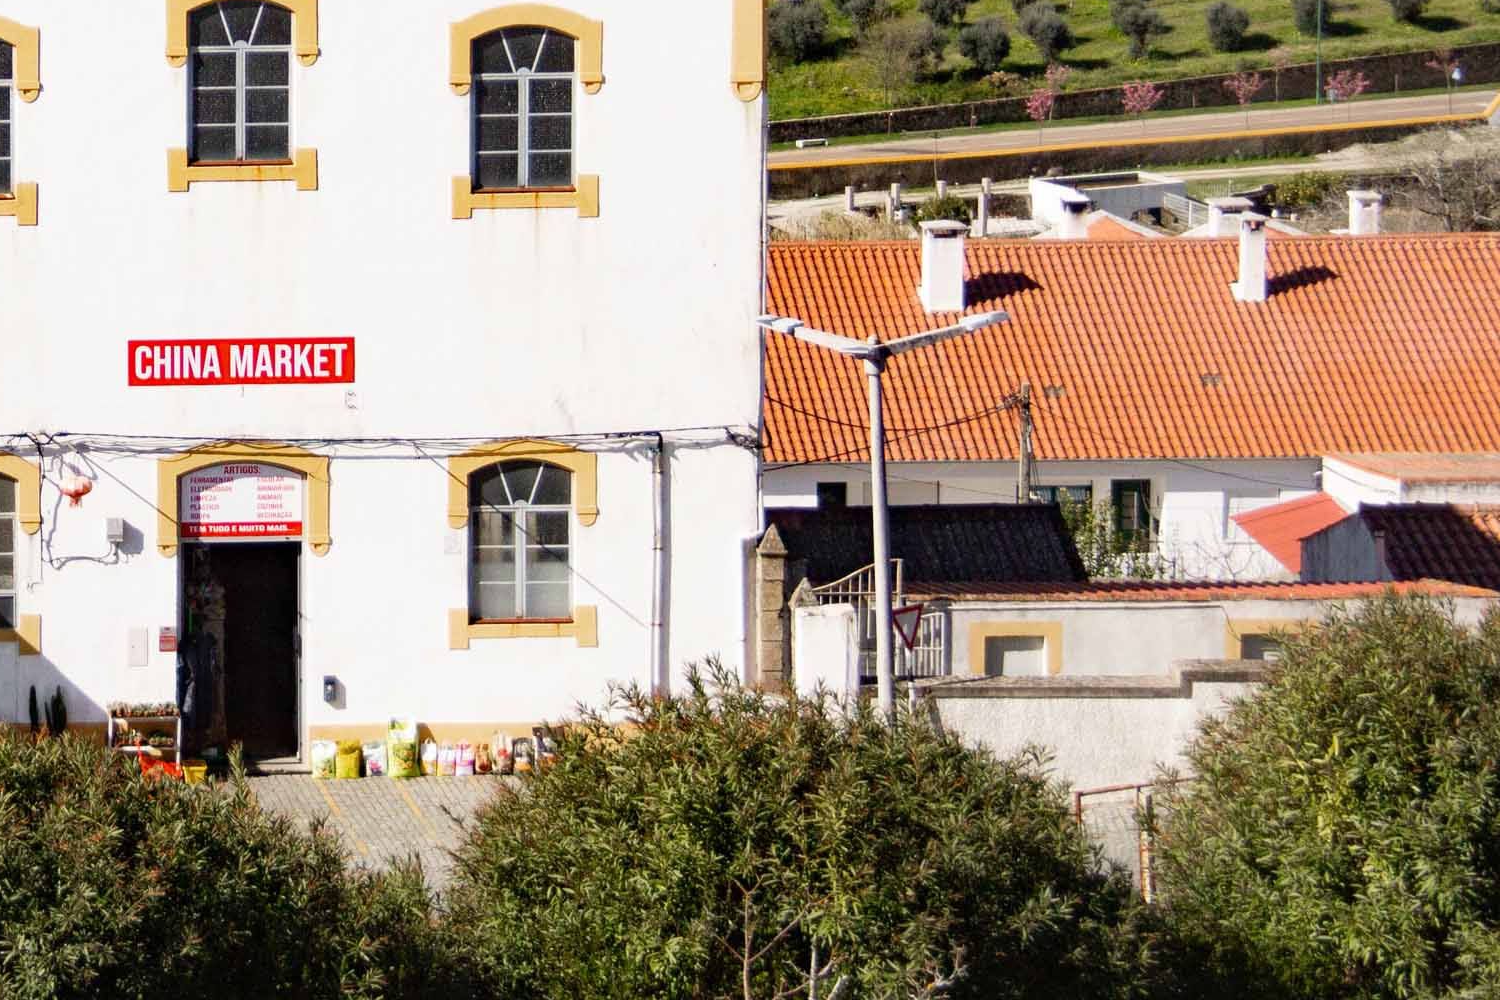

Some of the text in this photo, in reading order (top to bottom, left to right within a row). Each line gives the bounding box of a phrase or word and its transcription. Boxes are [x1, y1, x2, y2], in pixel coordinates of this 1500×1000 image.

[134, 343, 348, 380] CHINA MARKET
[223, 465, 261, 474] ARTIGOS:
[189, 525, 207, 533] TEM
[208, 525, 230, 533] TUDO
